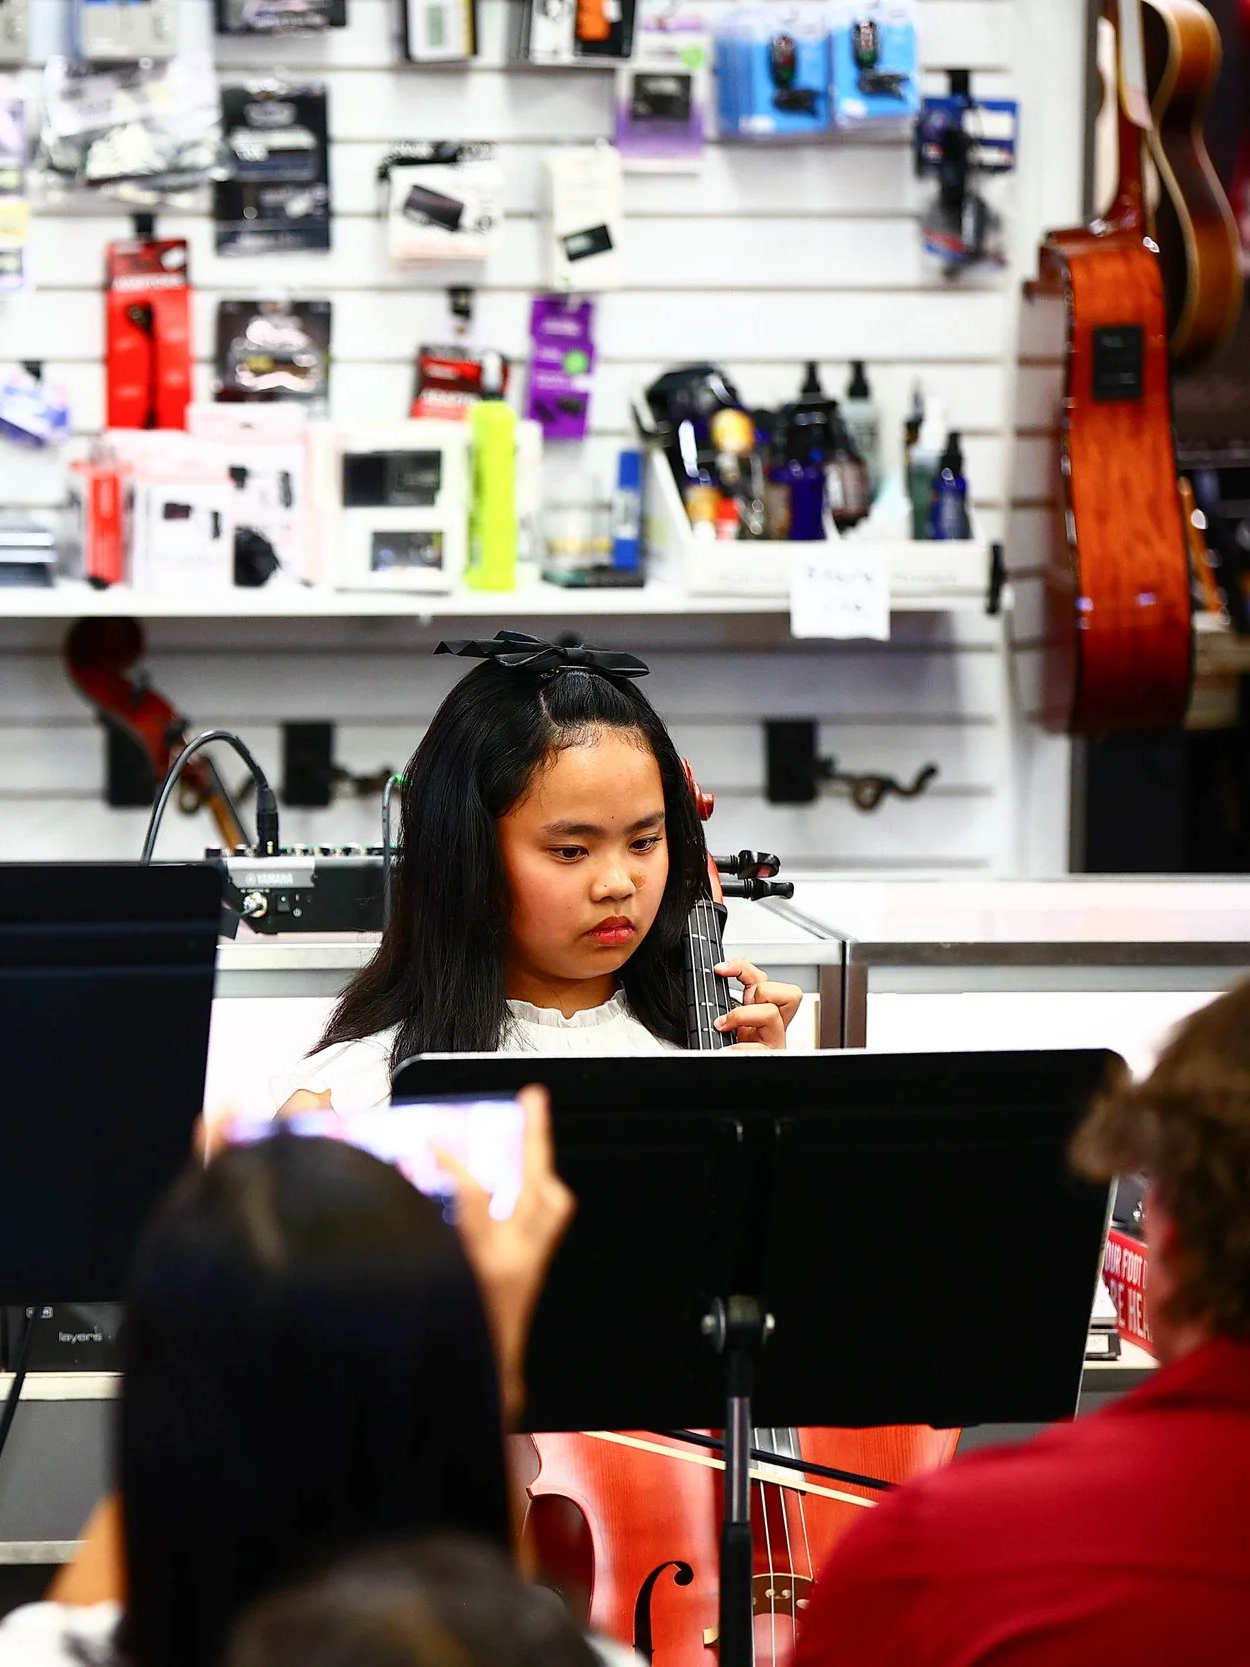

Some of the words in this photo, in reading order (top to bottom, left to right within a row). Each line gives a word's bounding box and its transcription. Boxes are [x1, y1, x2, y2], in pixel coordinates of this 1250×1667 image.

[257, 873, 294, 884] YAMAHA
[1122, 1247, 1143, 1287] FOOT
[58, 1332, 103, 1344] layers
